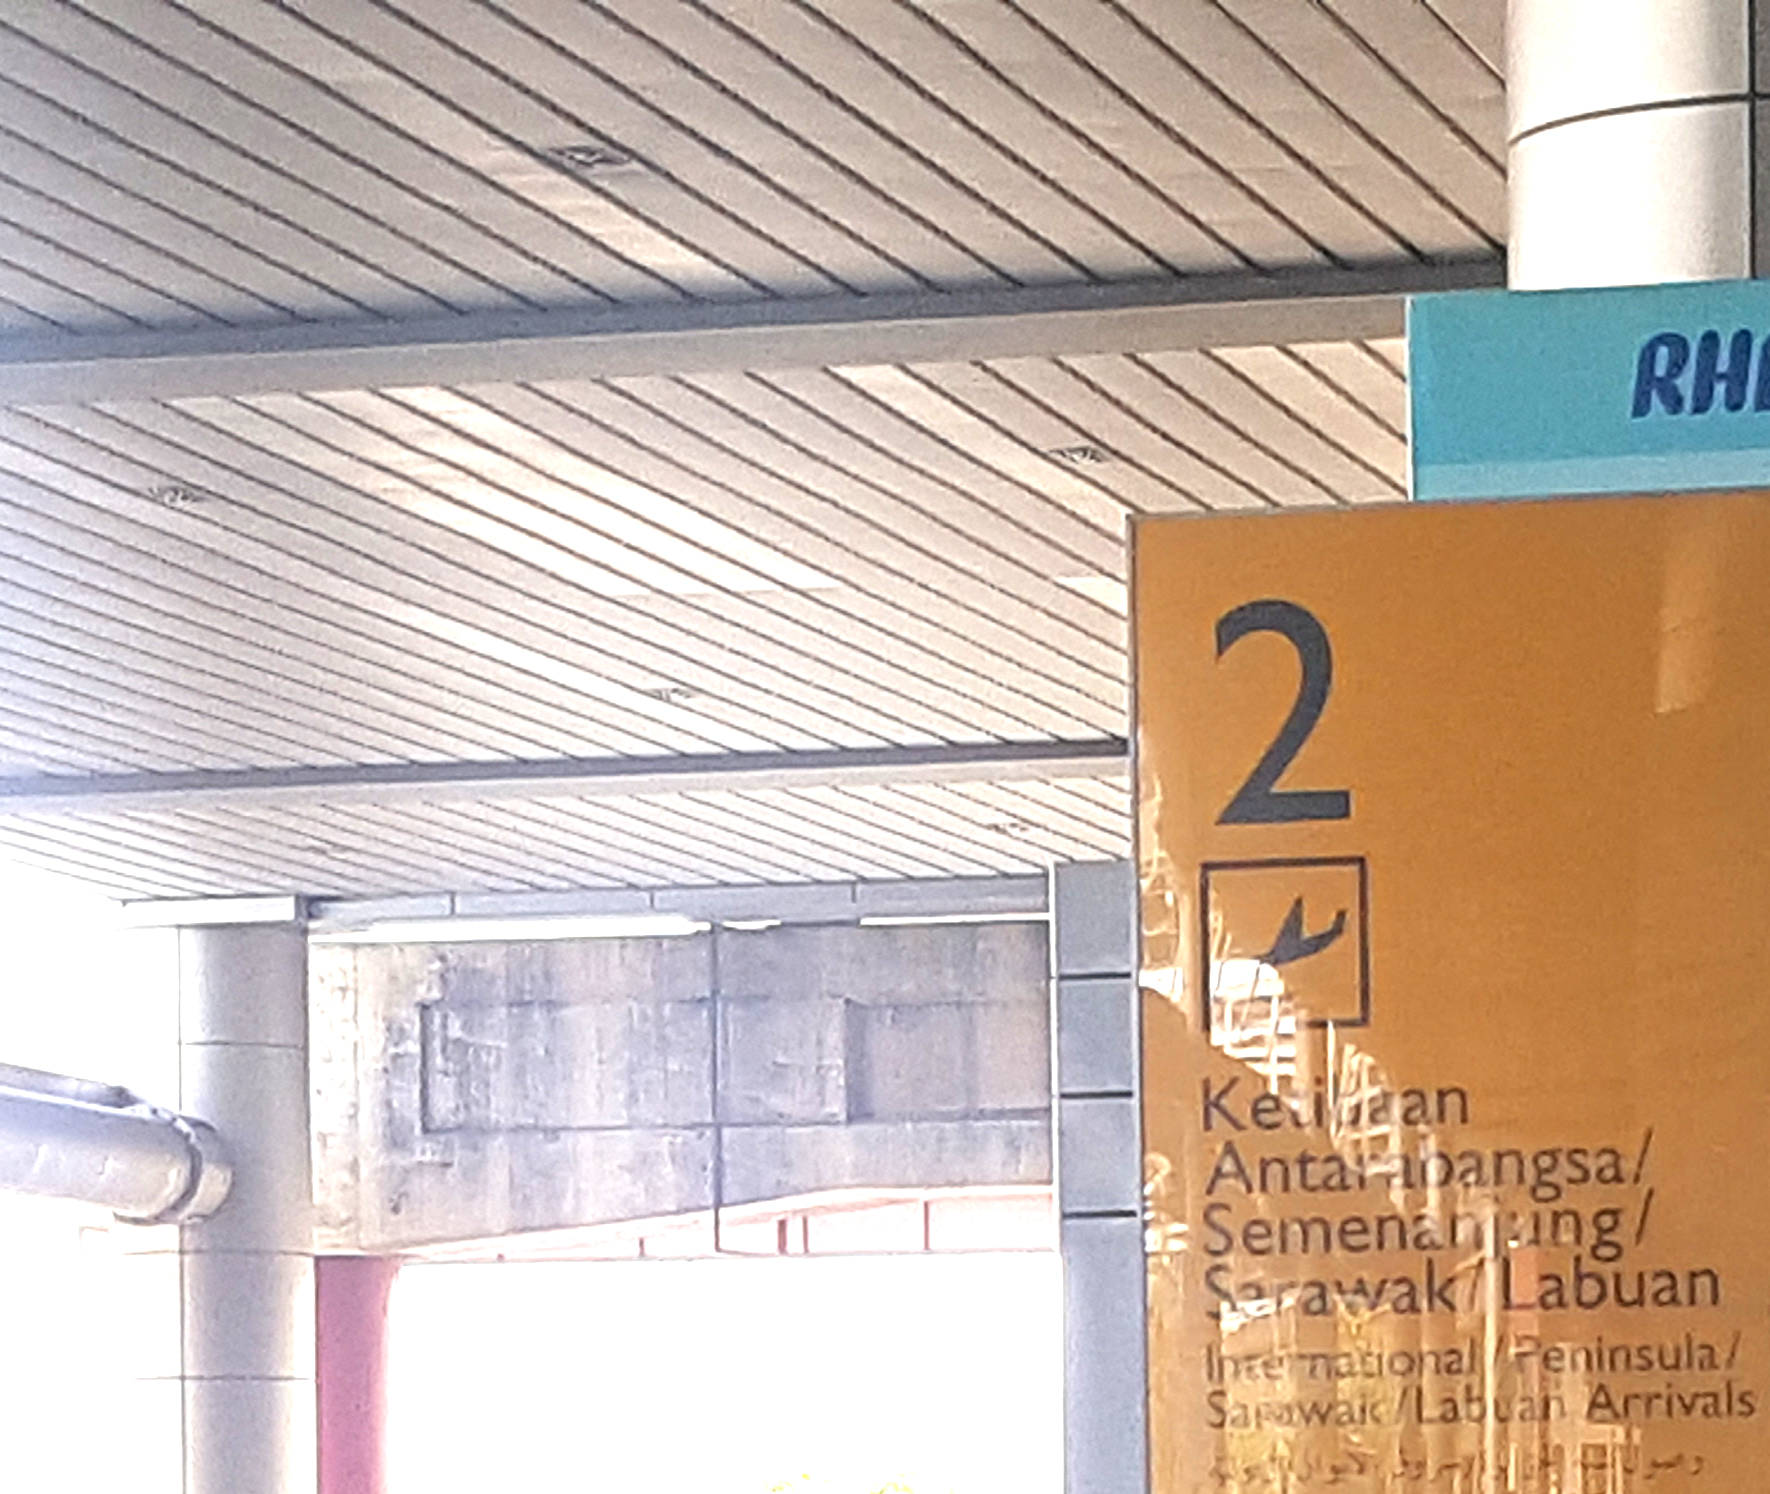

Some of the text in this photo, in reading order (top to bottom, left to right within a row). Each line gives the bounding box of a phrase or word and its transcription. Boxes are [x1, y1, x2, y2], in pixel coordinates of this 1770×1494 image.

[1214, 599, 1352, 826] 2
[1201, 1076, 1469, 1132] Keiaan
[1586, 1380, 1757, 1425] Arrivals
